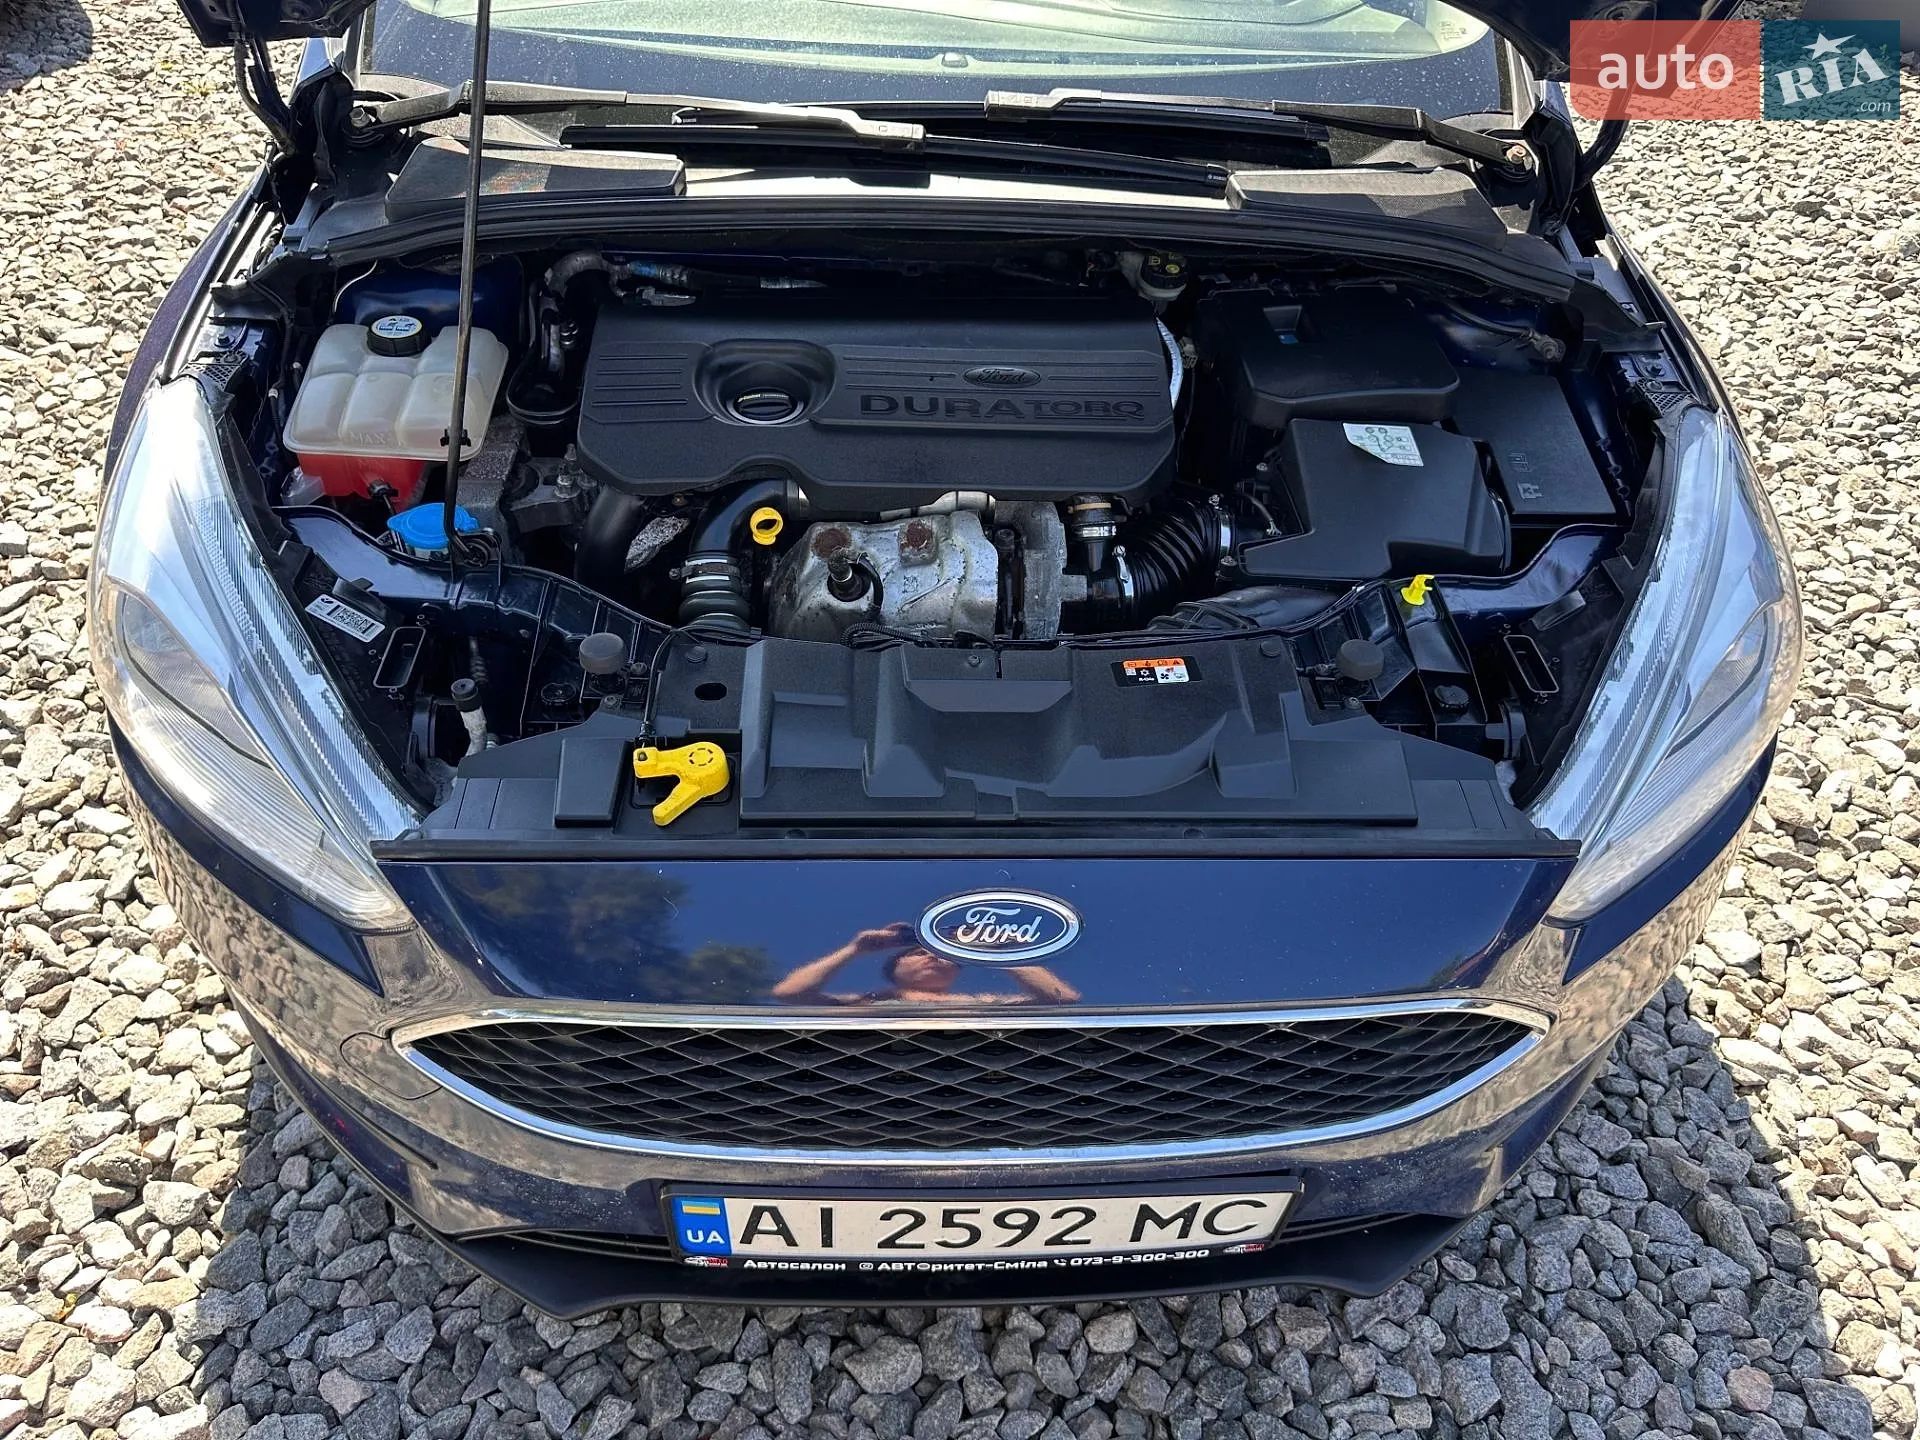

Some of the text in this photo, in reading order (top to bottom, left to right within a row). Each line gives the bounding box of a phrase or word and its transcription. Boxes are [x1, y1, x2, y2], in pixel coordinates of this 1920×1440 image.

[974, 368, 1028, 385] Ford
[859, 394, 1146, 420] DURATORQ
[956, 906, 1043, 943] Ford
[739, 1199, 1268, 1249] AI 2592 MC
[686, 1229, 725, 1244] UA
[743, 1259, 846, 1271] Автосалон
[1070, 1249, 1210, 1266] 073-9-300-300
